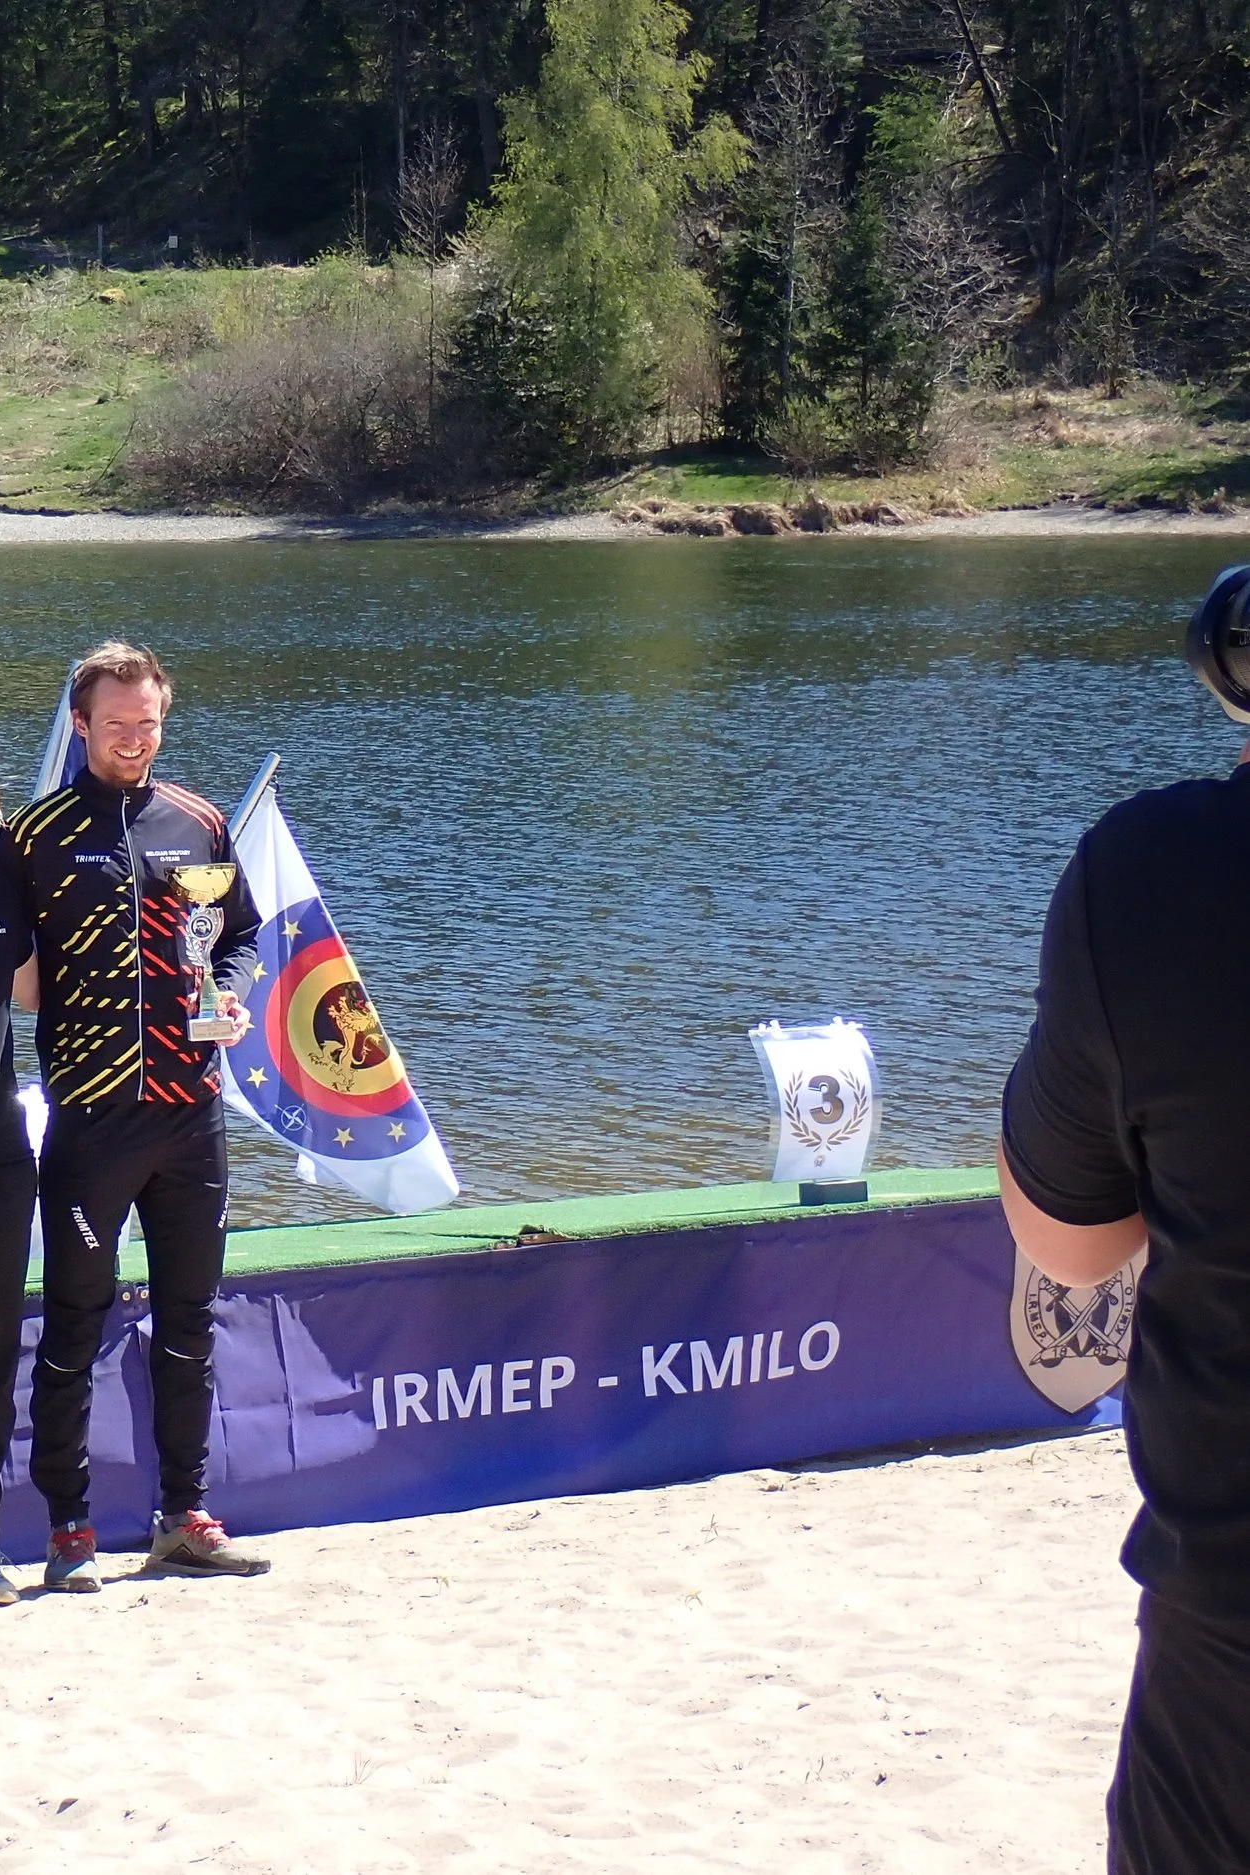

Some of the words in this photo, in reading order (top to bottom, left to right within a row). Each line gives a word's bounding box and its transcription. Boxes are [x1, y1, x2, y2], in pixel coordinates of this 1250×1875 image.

[74, 854, 111, 863] TRIMTEX
[808, 1074, 845, 1125] 3
[71, 1205, 100, 1250] TRIMTEX
[1052, 1345, 1068, 1358] 18
[1093, 1345, 1109, 1357] 85
[371, 1355, 576, 1431] IRMEP
[597, 1373, 619, 1388] -
[641, 1320, 841, 1398] KMILO
